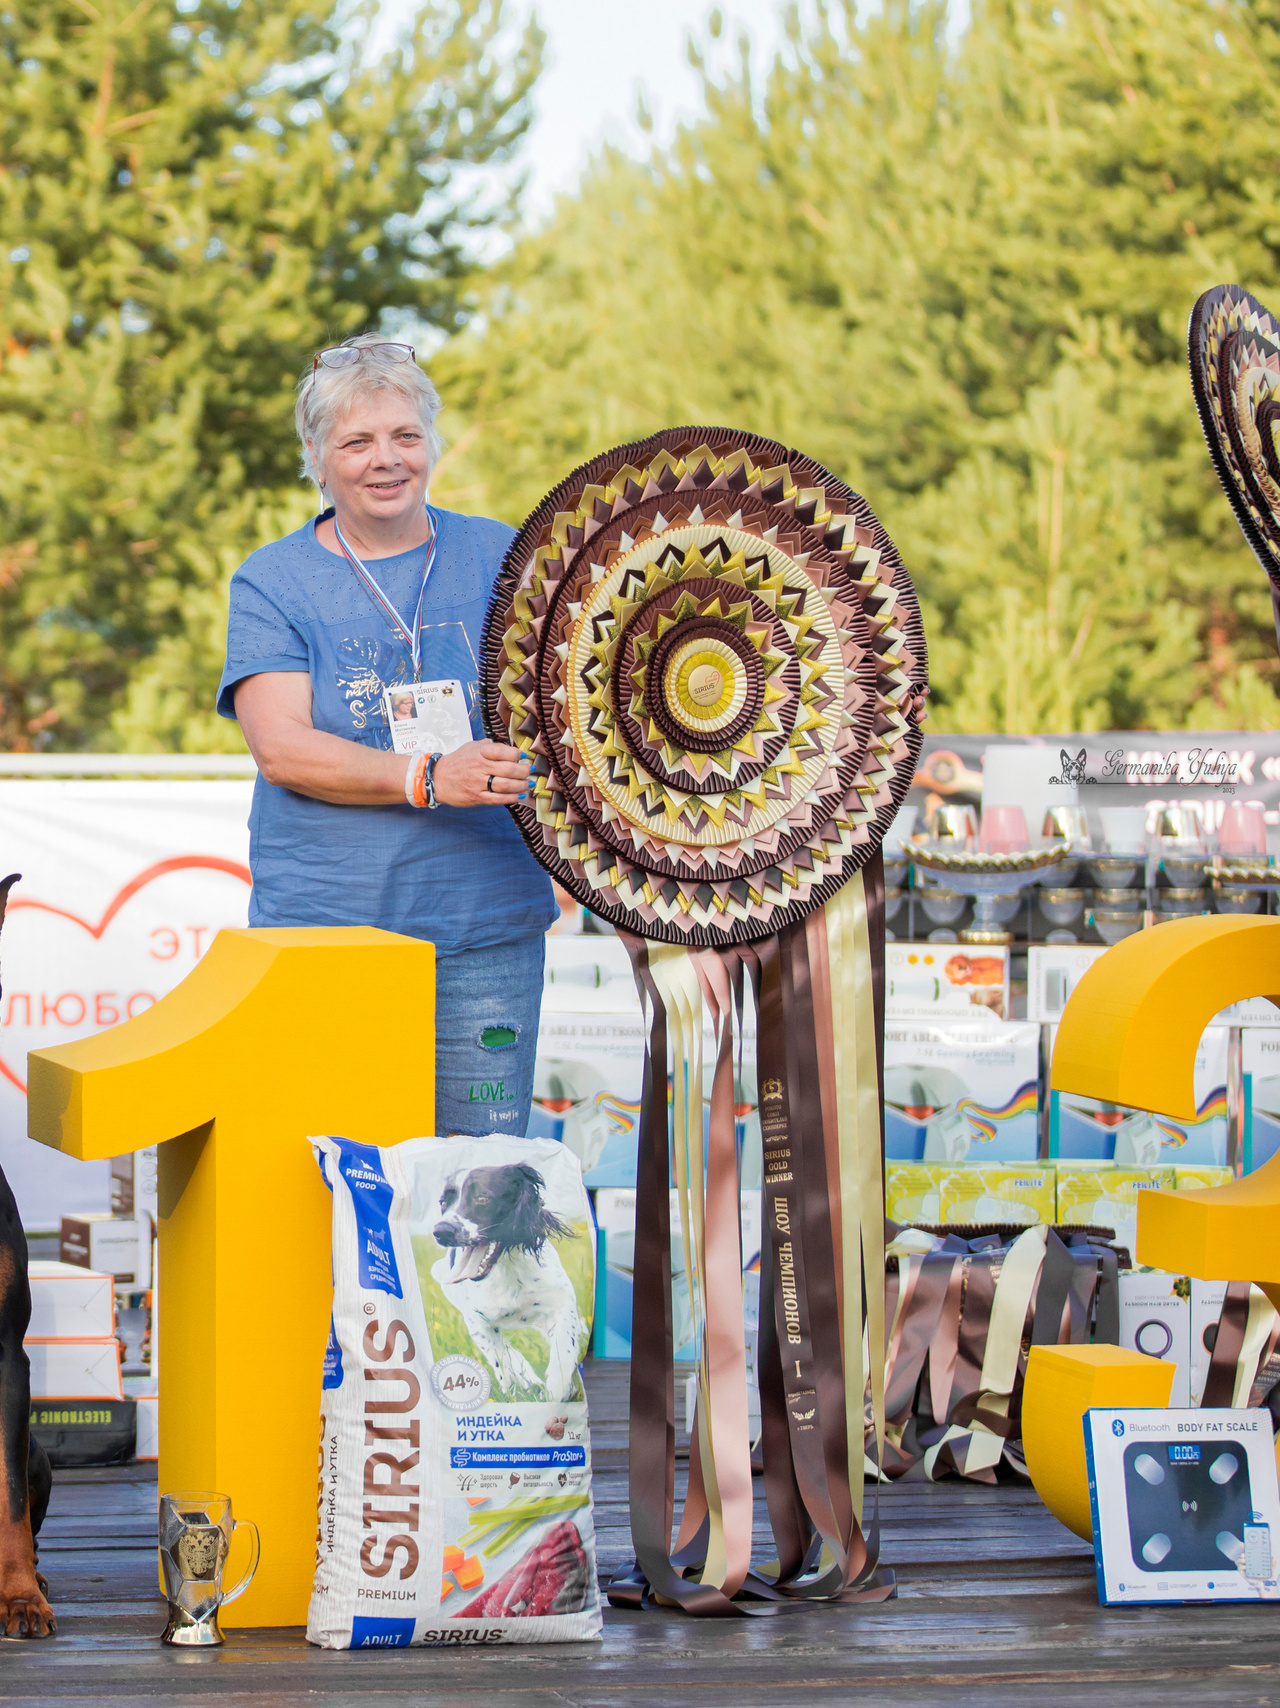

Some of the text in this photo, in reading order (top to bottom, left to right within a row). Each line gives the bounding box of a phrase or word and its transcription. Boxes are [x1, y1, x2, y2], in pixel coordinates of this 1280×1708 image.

[416, 686, 439, 695] SIRIUS
[693, 682, 715, 695] SIRIUS
[401, 740, 418, 750] VIP
[3, 991, 158, 1028] ЛЮБО
[581, 1025, 650, 1038] ELECTRON
[885, 1031, 909, 1042] ORT
[468, 1081, 505, 1102] LOVE
[764, 1149, 791, 1160] SIRIUS
[768, 1160, 788, 1171] GOLD
[765, 1171, 794, 1184] WINNER
[1014, 1179, 1044, 1188] FEILITE
[355, 1180, 377, 1191] FOOD
[1132, 1180, 1161, 1190] FEILITE
[774, 1196, 791, 1236] ШОУ
[366, 1239, 391, 1266] ADULT
[28, 926, 436, 1631] 1
[778, 1241, 802, 1345] ЧЕМПИОНОВ
[443, 1374, 480, 1392] 44%
[39, 1410, 113, 1424] ELECTRONIC
[456, 1412, 523, 1427] ИНДЕЙКА
[1128, 1422, 1259, 1433] Bluetooth BODY FAT SCALE
[457, 1430, 505, 1442] И УТКА
[359, 1318, 421, 1581] SIRIUS
[472, 1451, 584, 1464] Комплекс пробиотиков ProStor+
[480, 1473, 503, 1481] Здоровая
[480, 1481, 498, 1489] шерсть
[327, 1434, 338, 1553] ИНДЕЙКА И УТКА
[357, 1588, 417, 1601] PREMIUM
[361, 1633, 402, 1647] ADULT
[423, 1628, 503, 1644] SIRIUS
